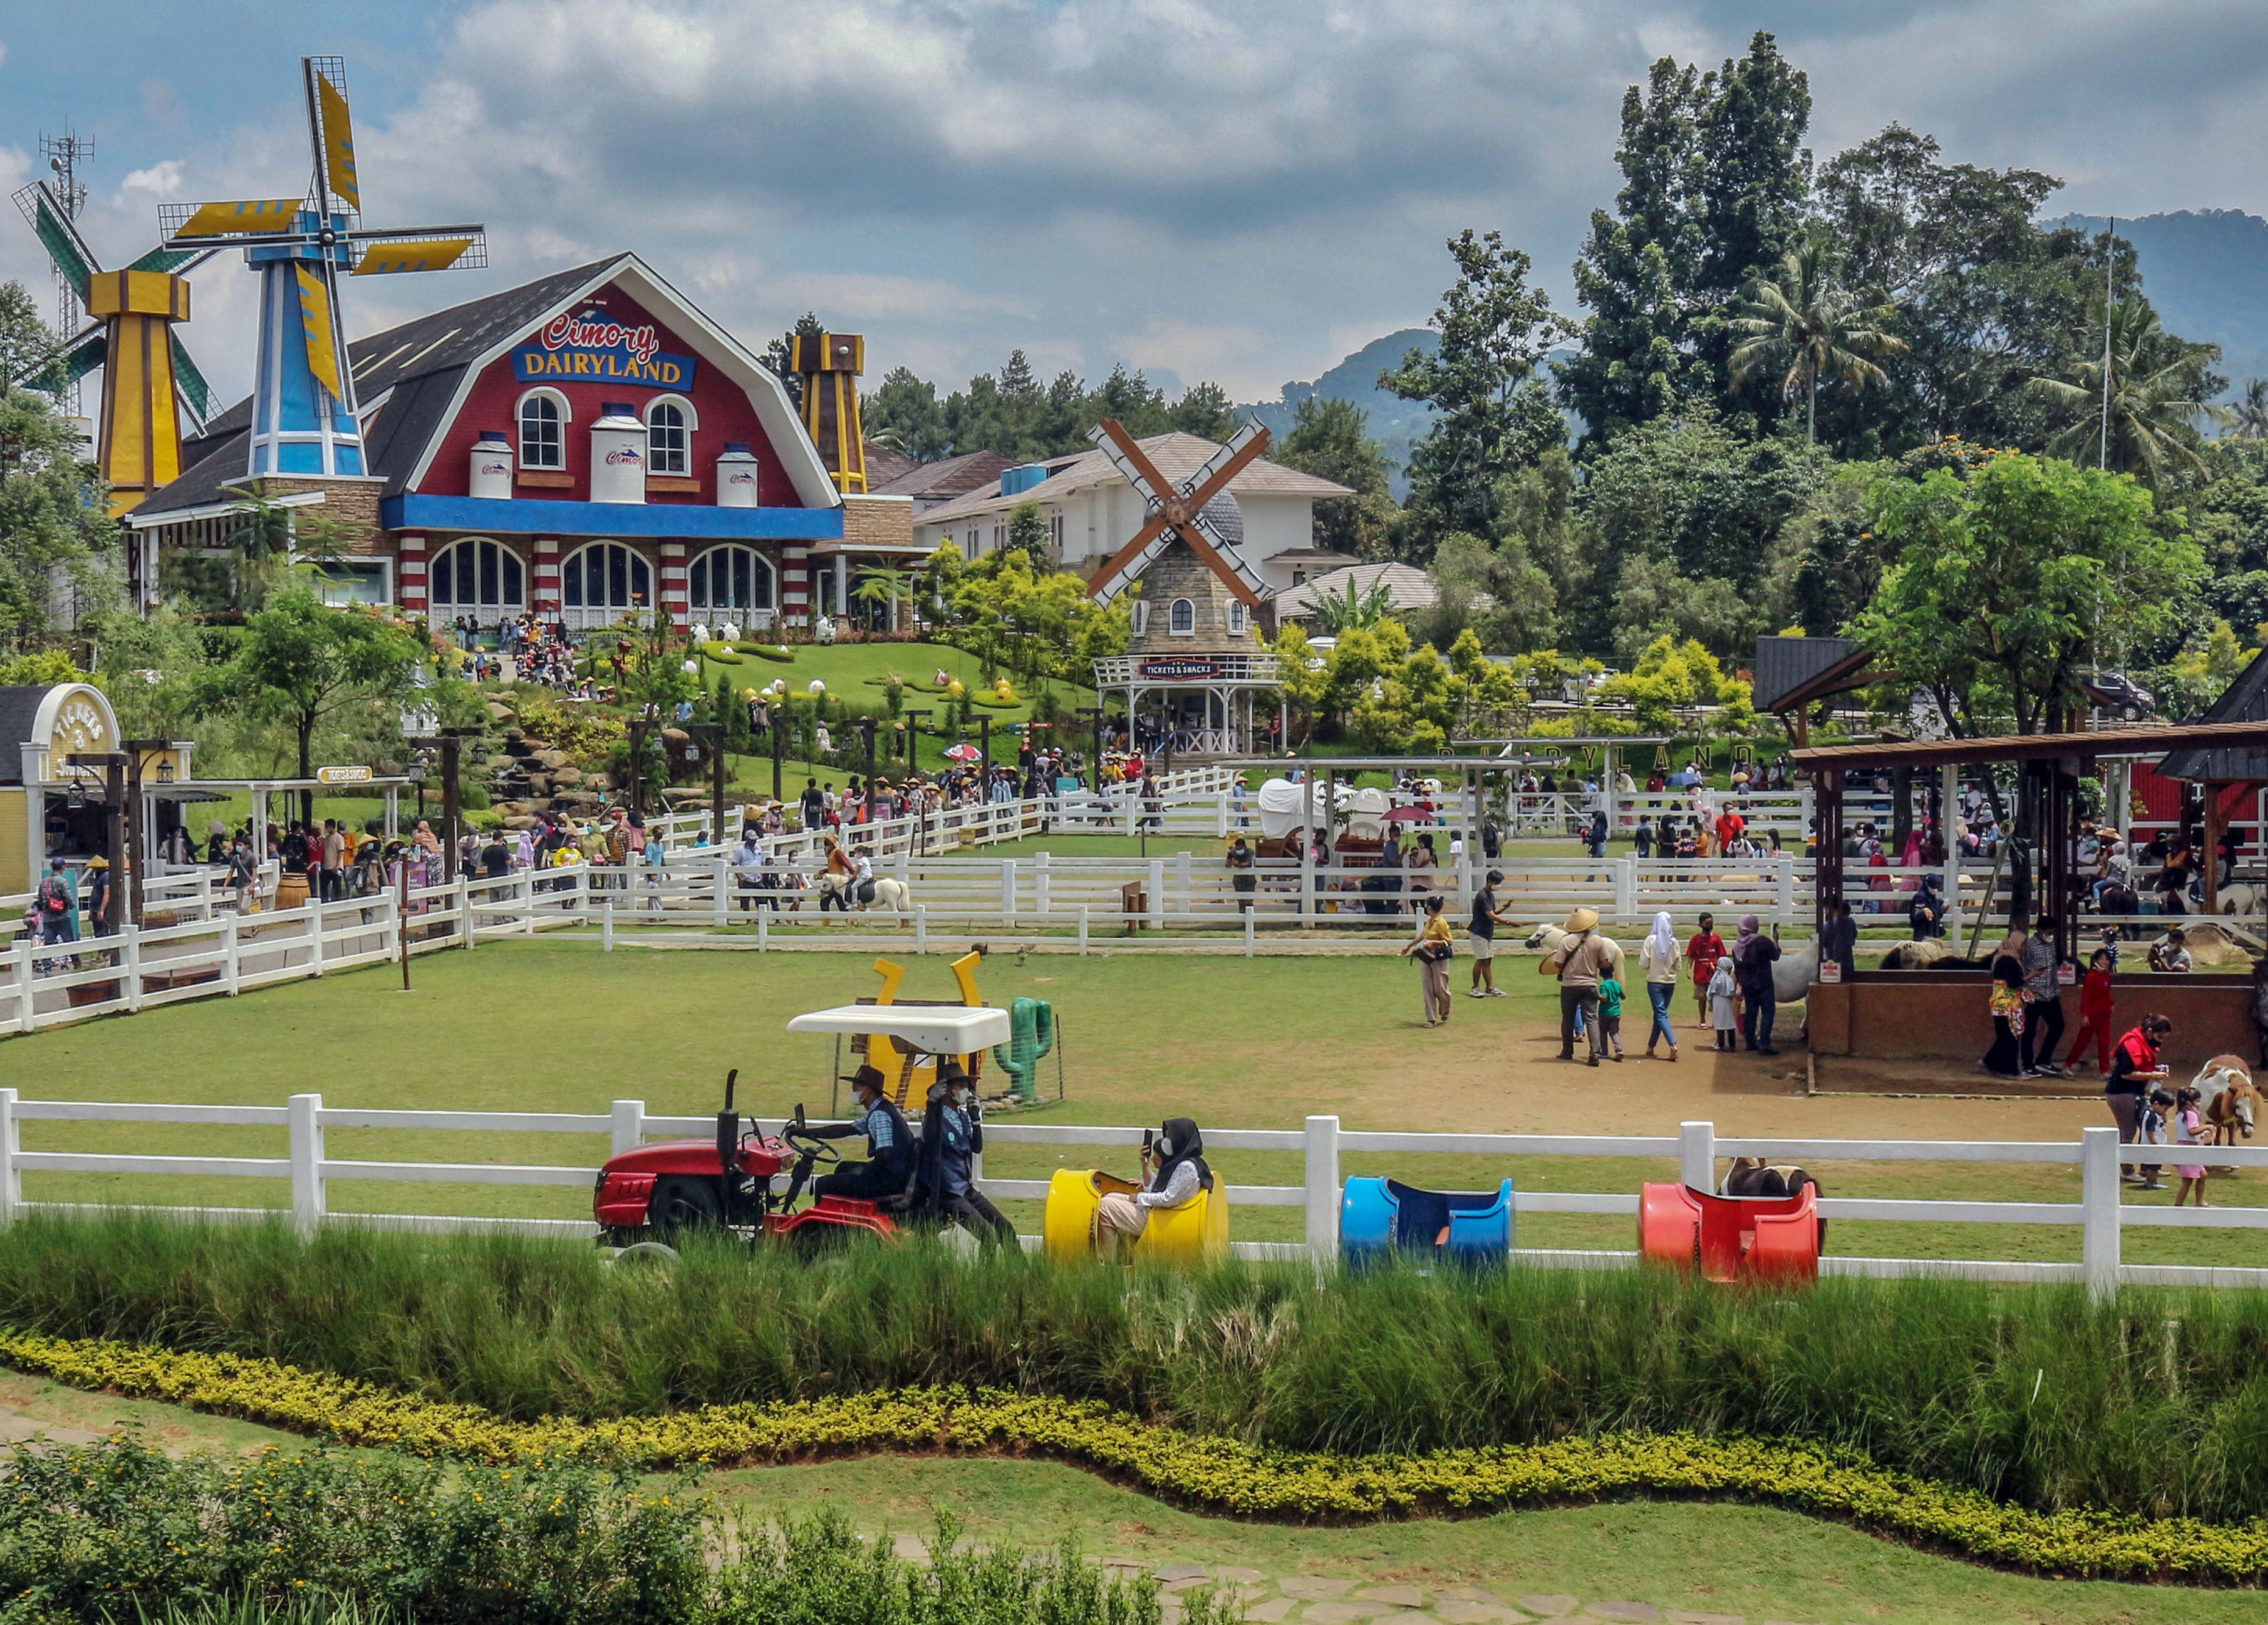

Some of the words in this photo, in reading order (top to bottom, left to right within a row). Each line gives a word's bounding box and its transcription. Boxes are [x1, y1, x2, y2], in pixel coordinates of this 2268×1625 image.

[542, 313, 659, 364] Cimory
[525, 353, 681, 383] DAIRYLAND
[482, 465, 512, 479] Cimory
[606, 451, 645, 470] Cimory
[55, 703, 103, 740] TICKETS
[75, 729, 85, 748] &
